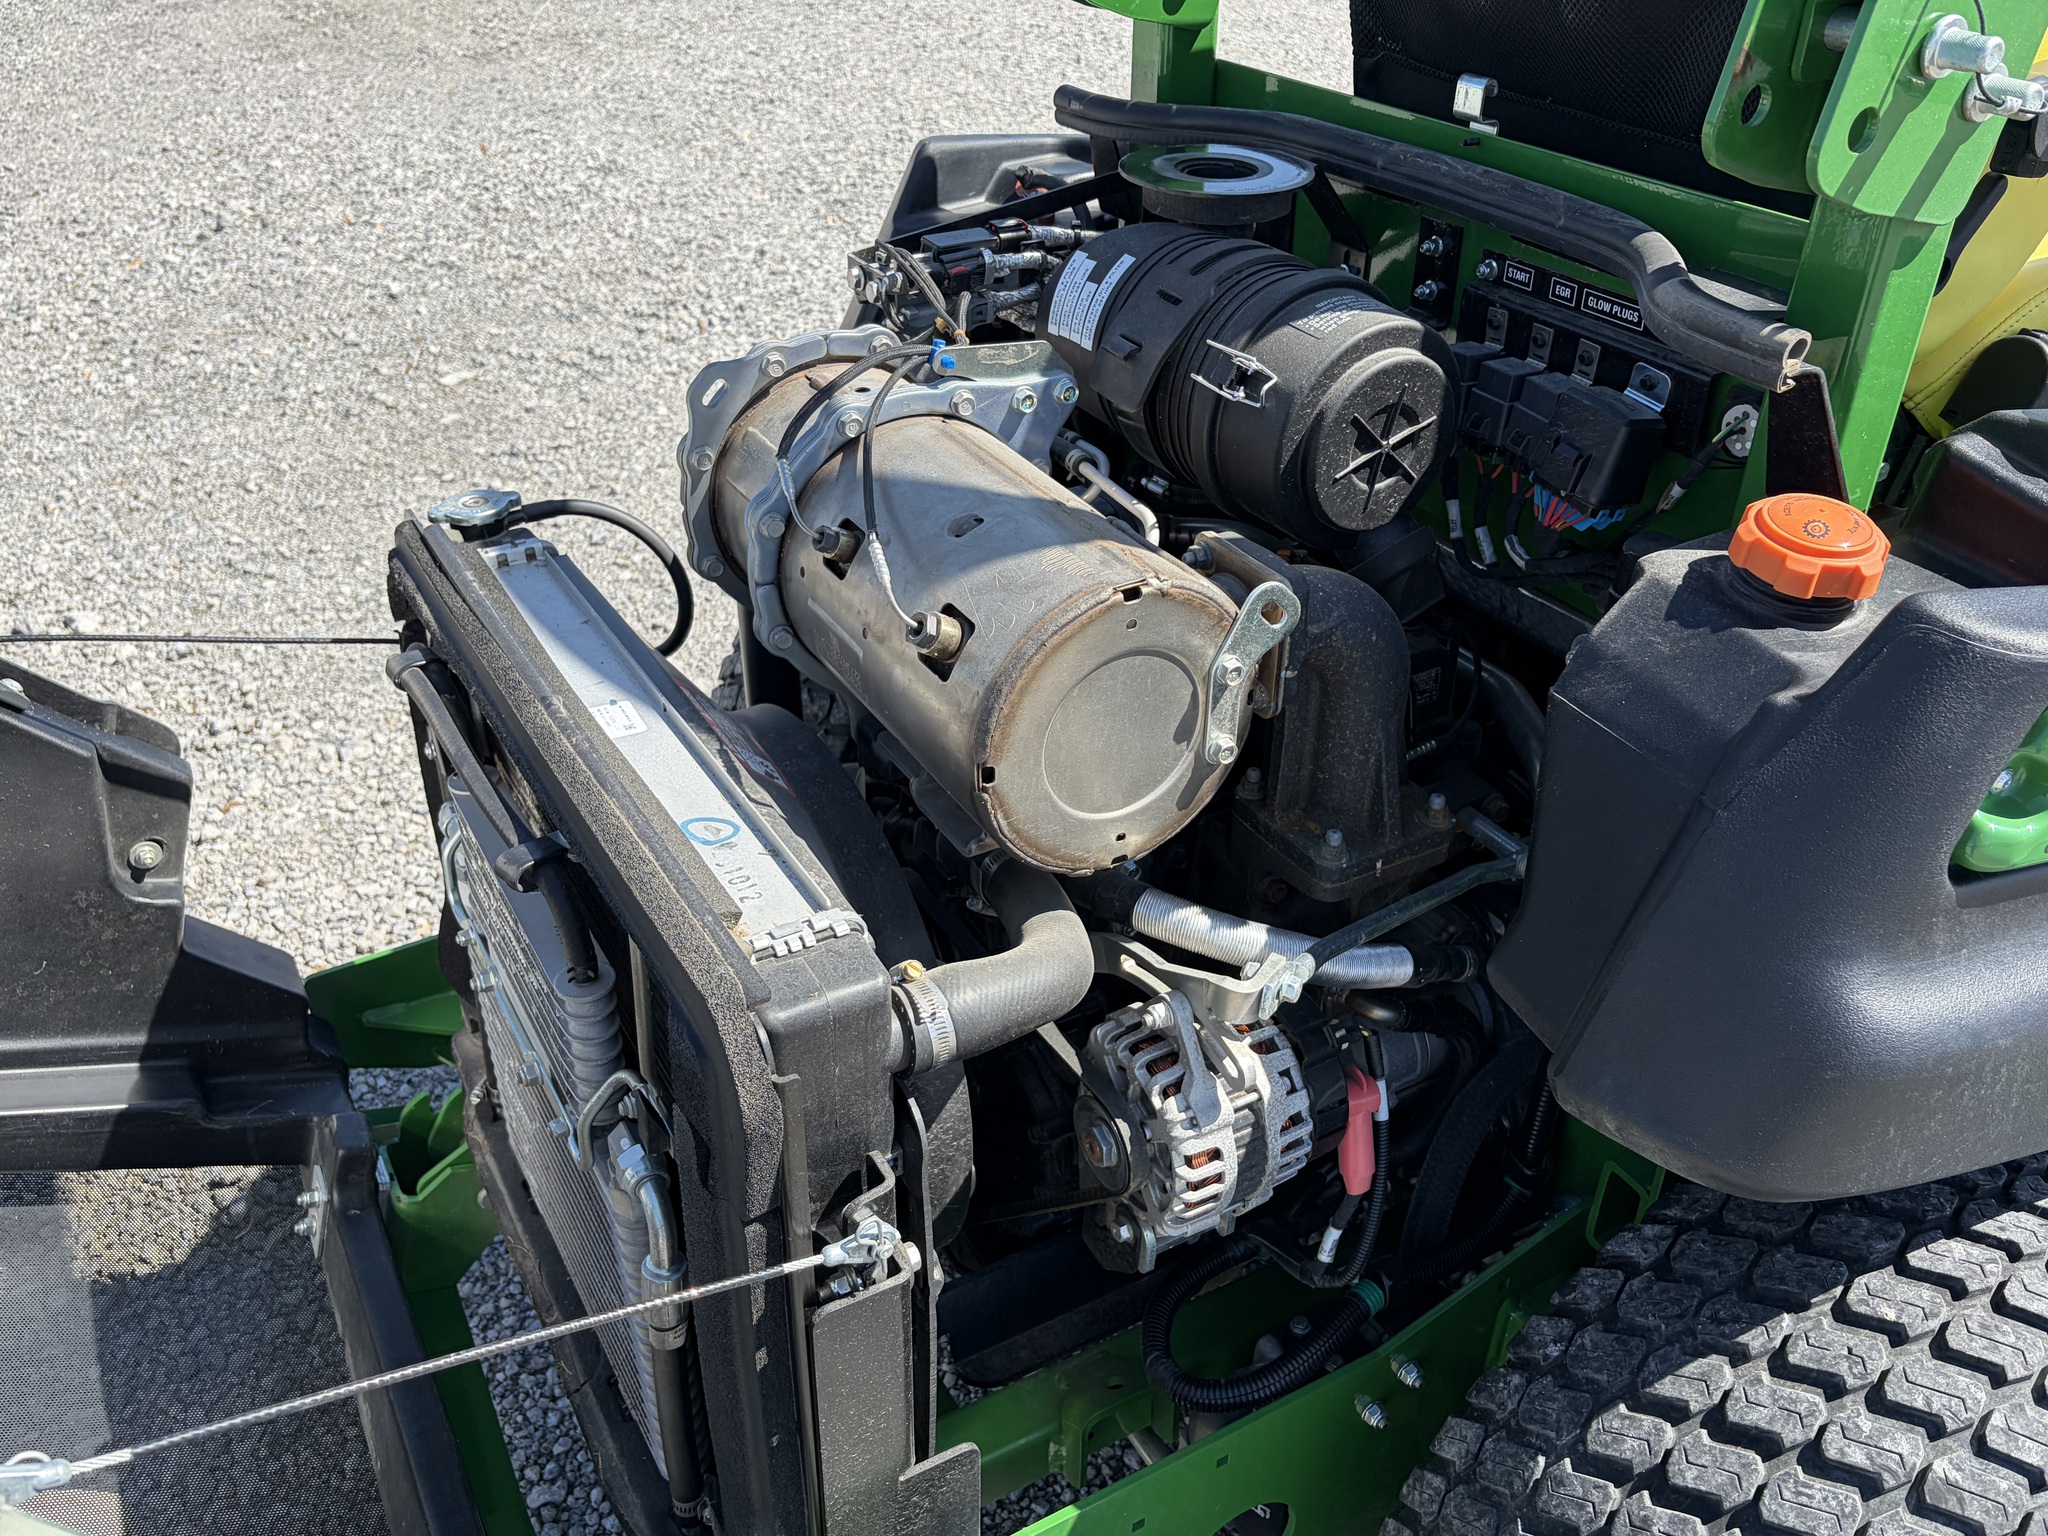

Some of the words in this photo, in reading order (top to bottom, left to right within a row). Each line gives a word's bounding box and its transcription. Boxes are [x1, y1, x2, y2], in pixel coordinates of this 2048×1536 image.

[1063, 259, 1076, 280] FILTER
[1108, 260, 1124, 280] FILTER
[1507, 267, 1531, 284] START
[1555, 284, 1571, 299] EGR
[1587, 296, 1612, 313] GLOW
[1612, 305, 1639, 322] PLUGS
[1308, 317, 1320, 325] Do
[1314, 311, 1341, 328] Service
[1324, 323, 1337, 334] red
[1336, 316, 1352, 326] line
